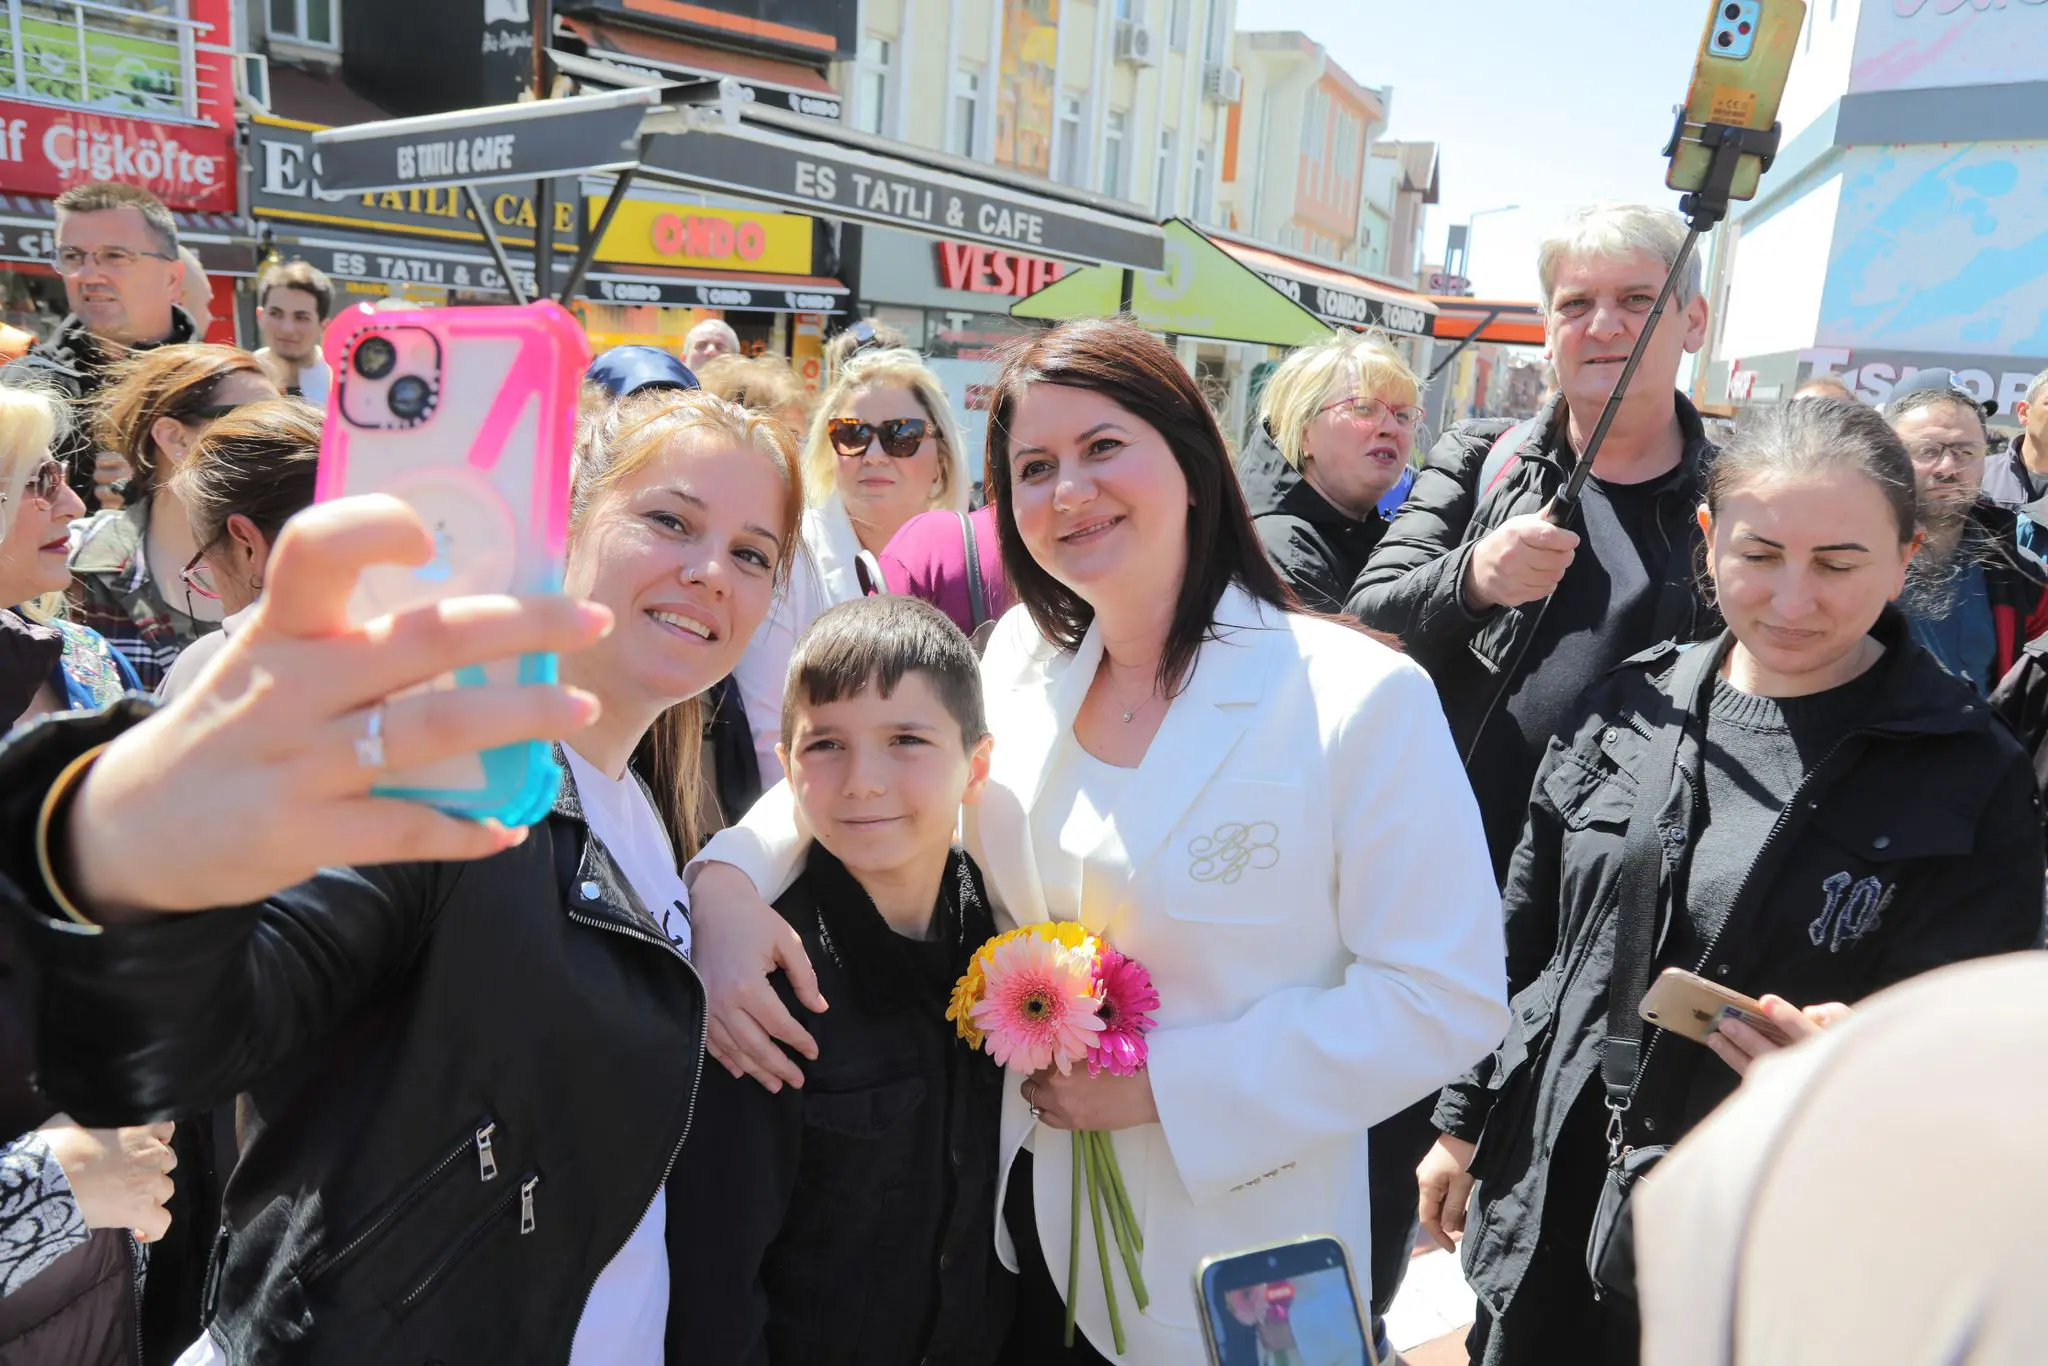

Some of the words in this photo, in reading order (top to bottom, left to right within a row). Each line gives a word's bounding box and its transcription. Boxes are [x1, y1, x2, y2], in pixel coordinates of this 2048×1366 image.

[43, 125, 215, 185] Çiğköfte
[397, 146, 416, 179] ES
[417, 141, 455, 176] TATLI
[471, 134, 515, 173] CAFE
[494, 193, 574, 233] CAE
[794, 160, 837, 200] ES
[852, 173, 933, 221] TATLI
[945, 197, 964, 228] &
[978, 204, 1043, 244] CAFE
[654, 213, 766, 261] ONDO
[332, 252, 367, 276] ES
[377, 257, 444, 284] TATLI
[453, 265, 471, 286] &
[1325, 294, 1368, 321] ONDO
